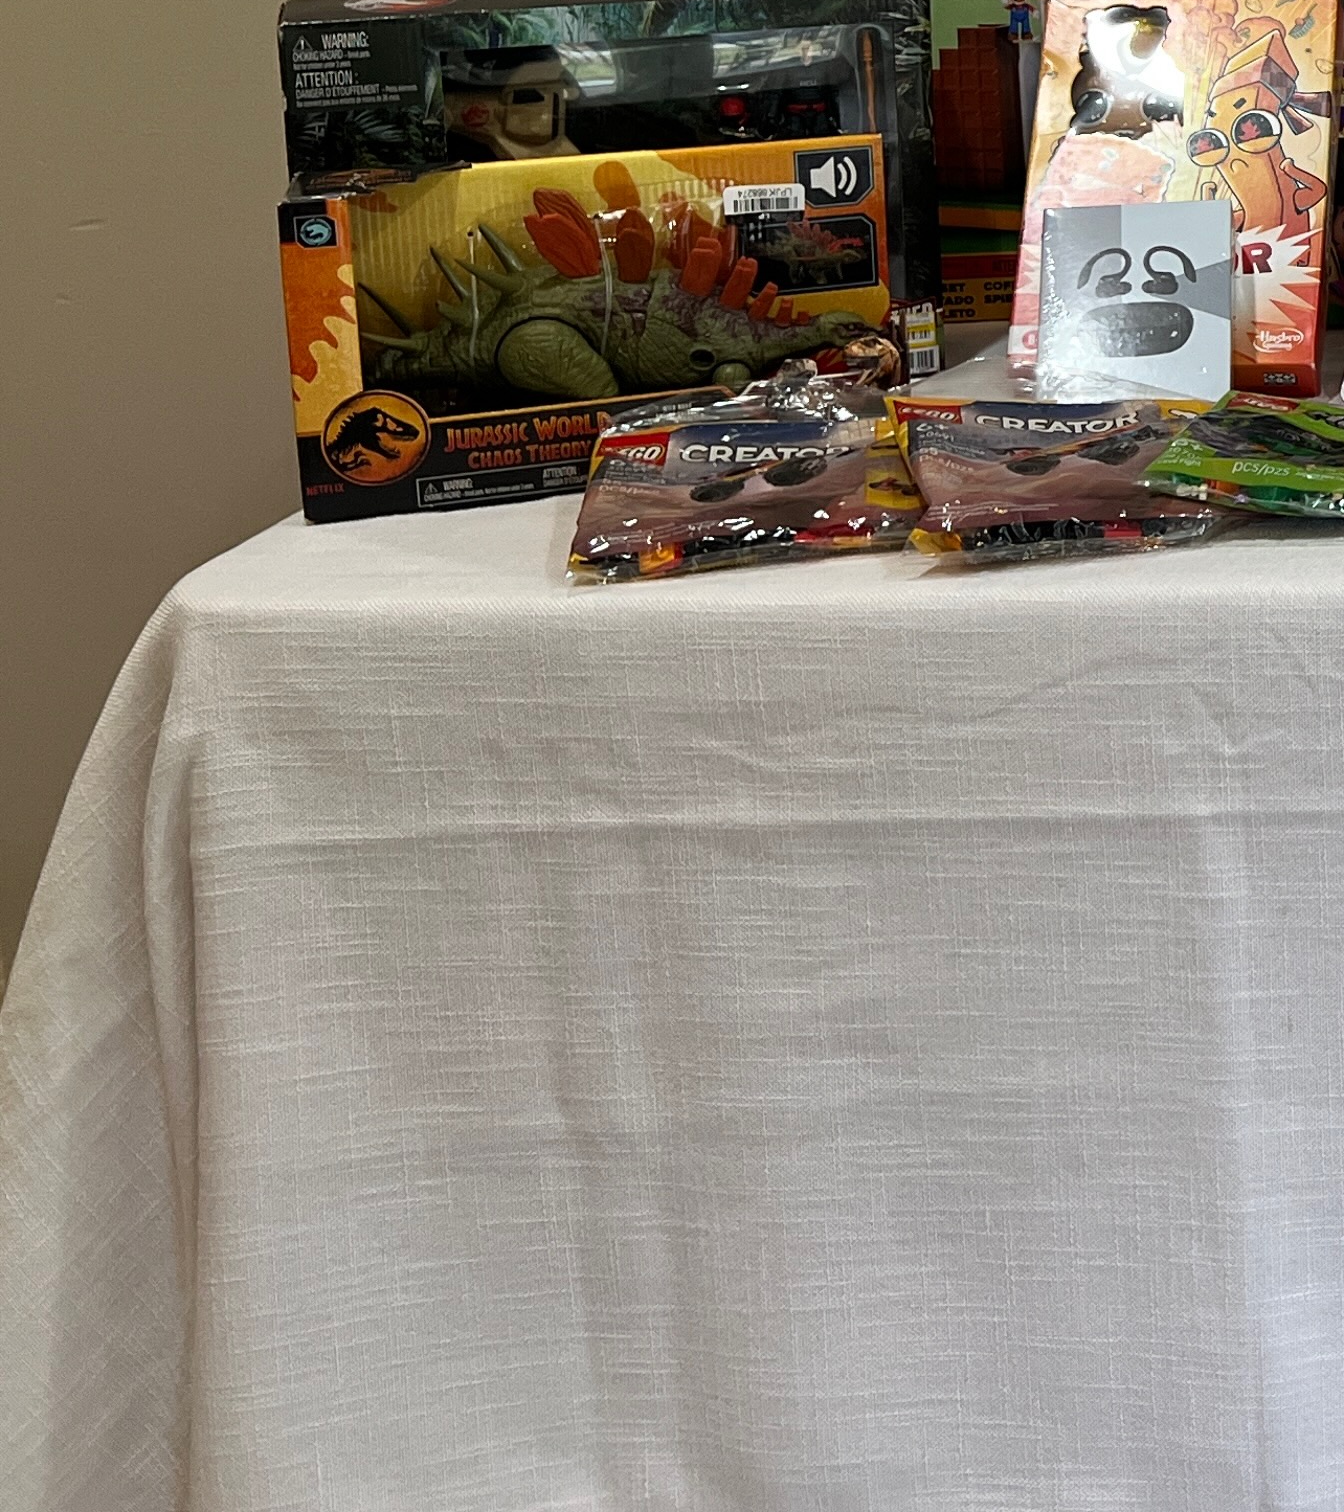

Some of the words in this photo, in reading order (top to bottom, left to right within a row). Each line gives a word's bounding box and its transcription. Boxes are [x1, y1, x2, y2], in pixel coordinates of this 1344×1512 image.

[321, 31, 370, 49] WARNING:
[320, 49, 343, 61] HAZARD
[295, 70, 353, 89] ATTENTION
[296, 88, 324, 100] DANGER
[1255, 330, 1302, 344] Hasbro
[444, 422, 528, 453] JURASSIC
[533, 411, 611, 441] WORLD
[974, 412, 1139, 434] CREATOR
[467, 445, 523, 470] CHAOS
[526, 439, 592, 462] THEORY
[1231, 459, 1291, 477] pcs/pzs
[306, 483, 345, 497] NETFLIX
